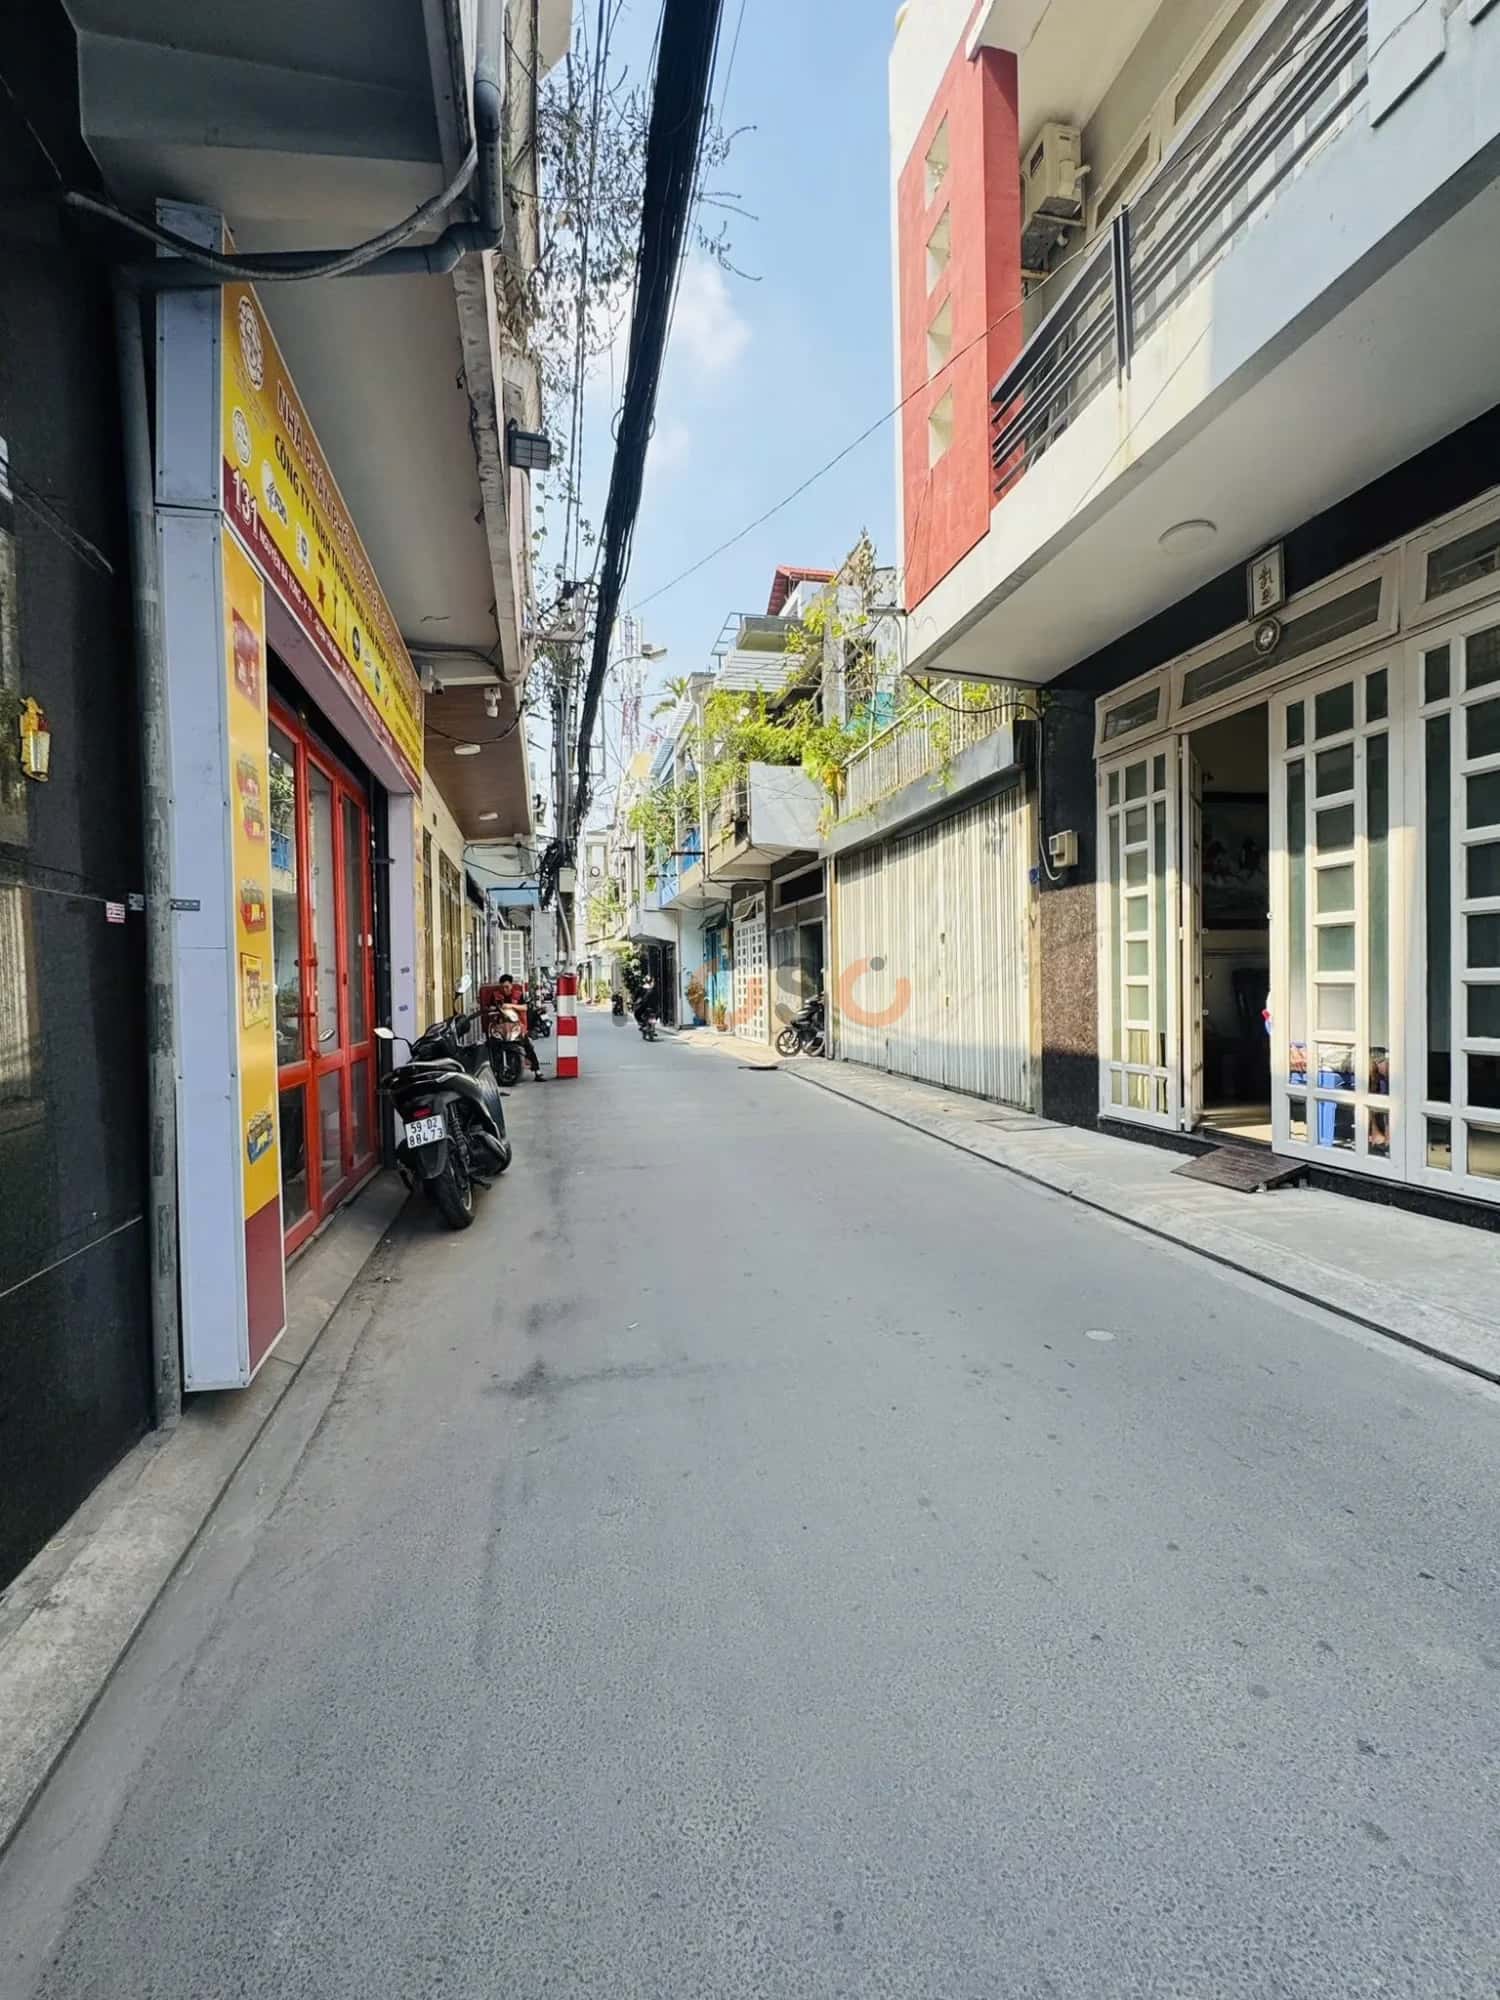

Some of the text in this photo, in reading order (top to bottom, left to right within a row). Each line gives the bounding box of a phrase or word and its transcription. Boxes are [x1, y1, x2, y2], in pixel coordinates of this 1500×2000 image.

[277, 379, 303, 462] NHÀ
[232, 468, 258, 541] 131
[274, 432, 299, 497] CÔNG
[300, 486, 310, 517] TY
[310, 507, 331, 558] TNHH
